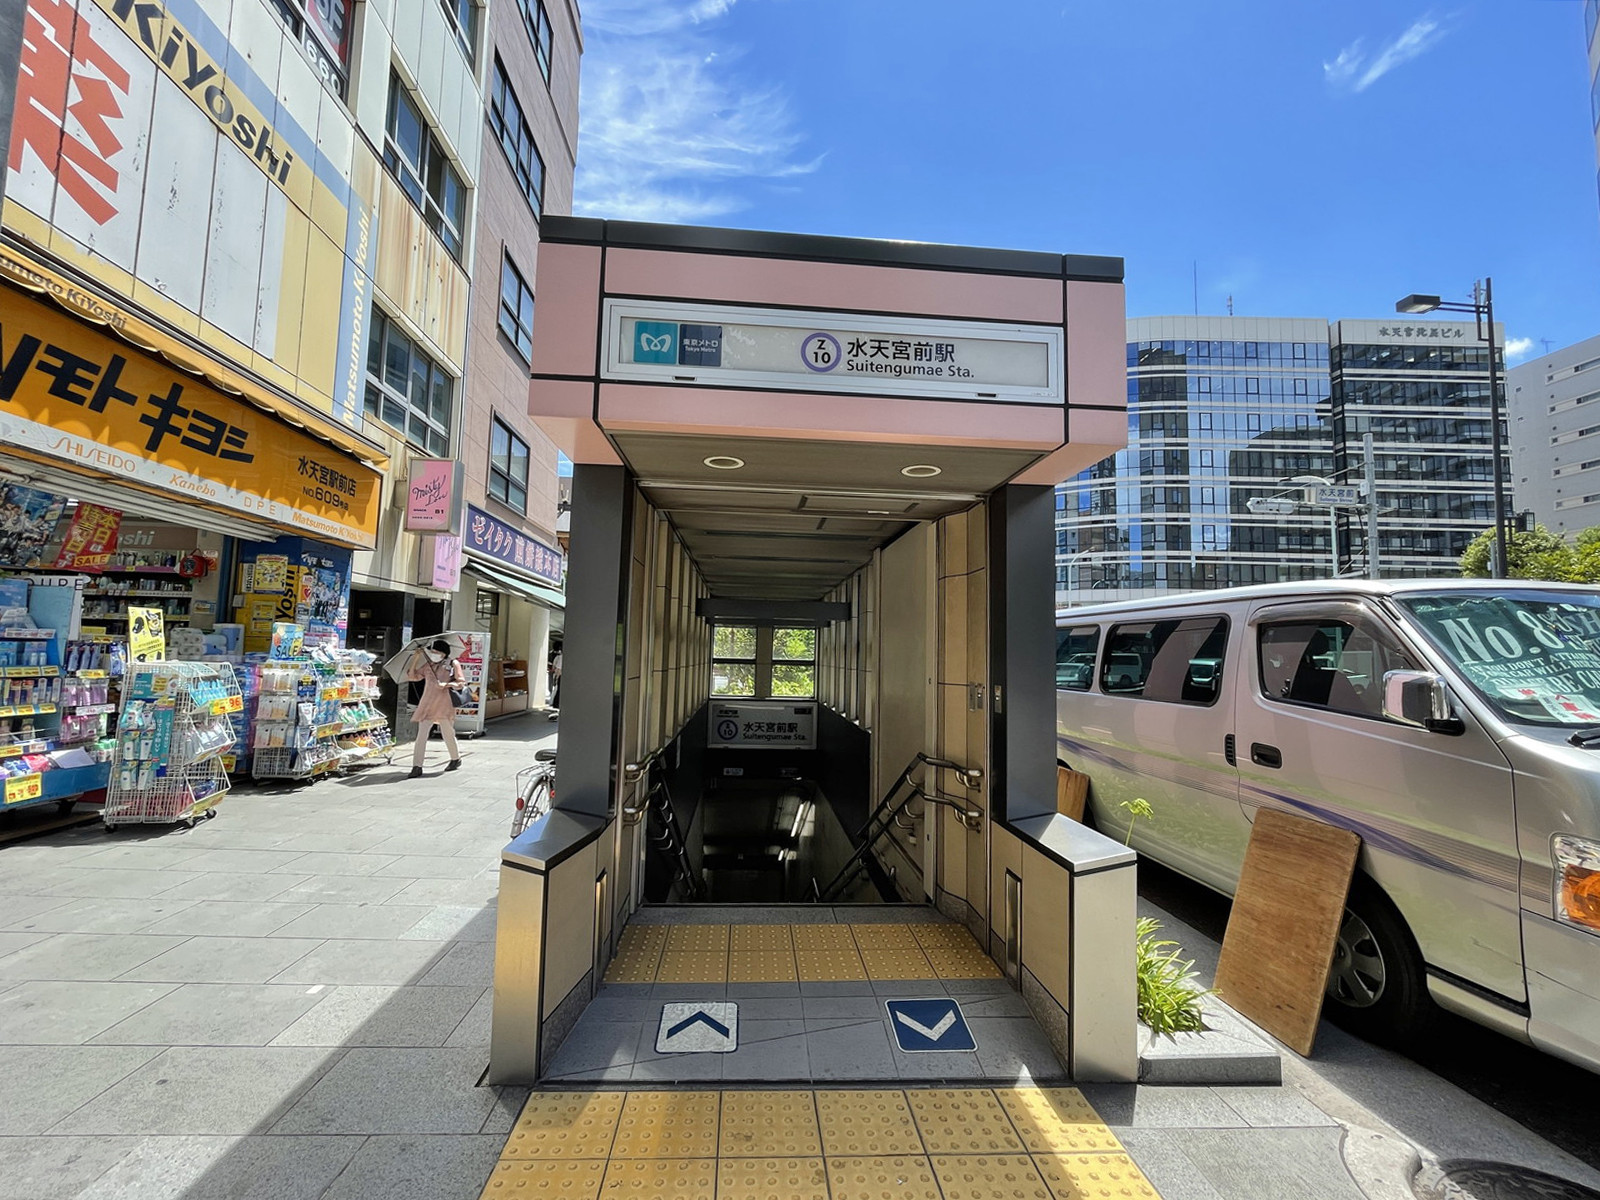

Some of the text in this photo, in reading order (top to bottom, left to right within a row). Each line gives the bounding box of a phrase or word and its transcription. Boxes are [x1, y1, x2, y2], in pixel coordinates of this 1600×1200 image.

[683, 338, 719, 348] 東京メトロ
[817, 339, 826, 350] Z
[847, 337, 955, 363] 水天宮前駅
[342, 295, 363, 427] Matsumoto
[813, 351, 831, 364] 10
[846, 359, 975, 378] Suitengumae Sta.
[47, 436, 136, 473] SHISEIDO
[297, 455, 357, 498] 水天宮駅前店
[169, 473, 216, 498] Kanebo
[1318, 488, 1354, 498] 水天宮前
[292, 512, 338, 535] Matsumoto
[75, 554, 108, 566] SALE
[275, 644, 302, 657] SALE
[1507, 657, 1545, 671] DON'T
[1534, 661, 1571, 676] WILL
[1546, 673, 1584, 693] BE
[743, 722, 798, 733] 水天宮前駅
[742, 733, 792, 741] Suitengumae
